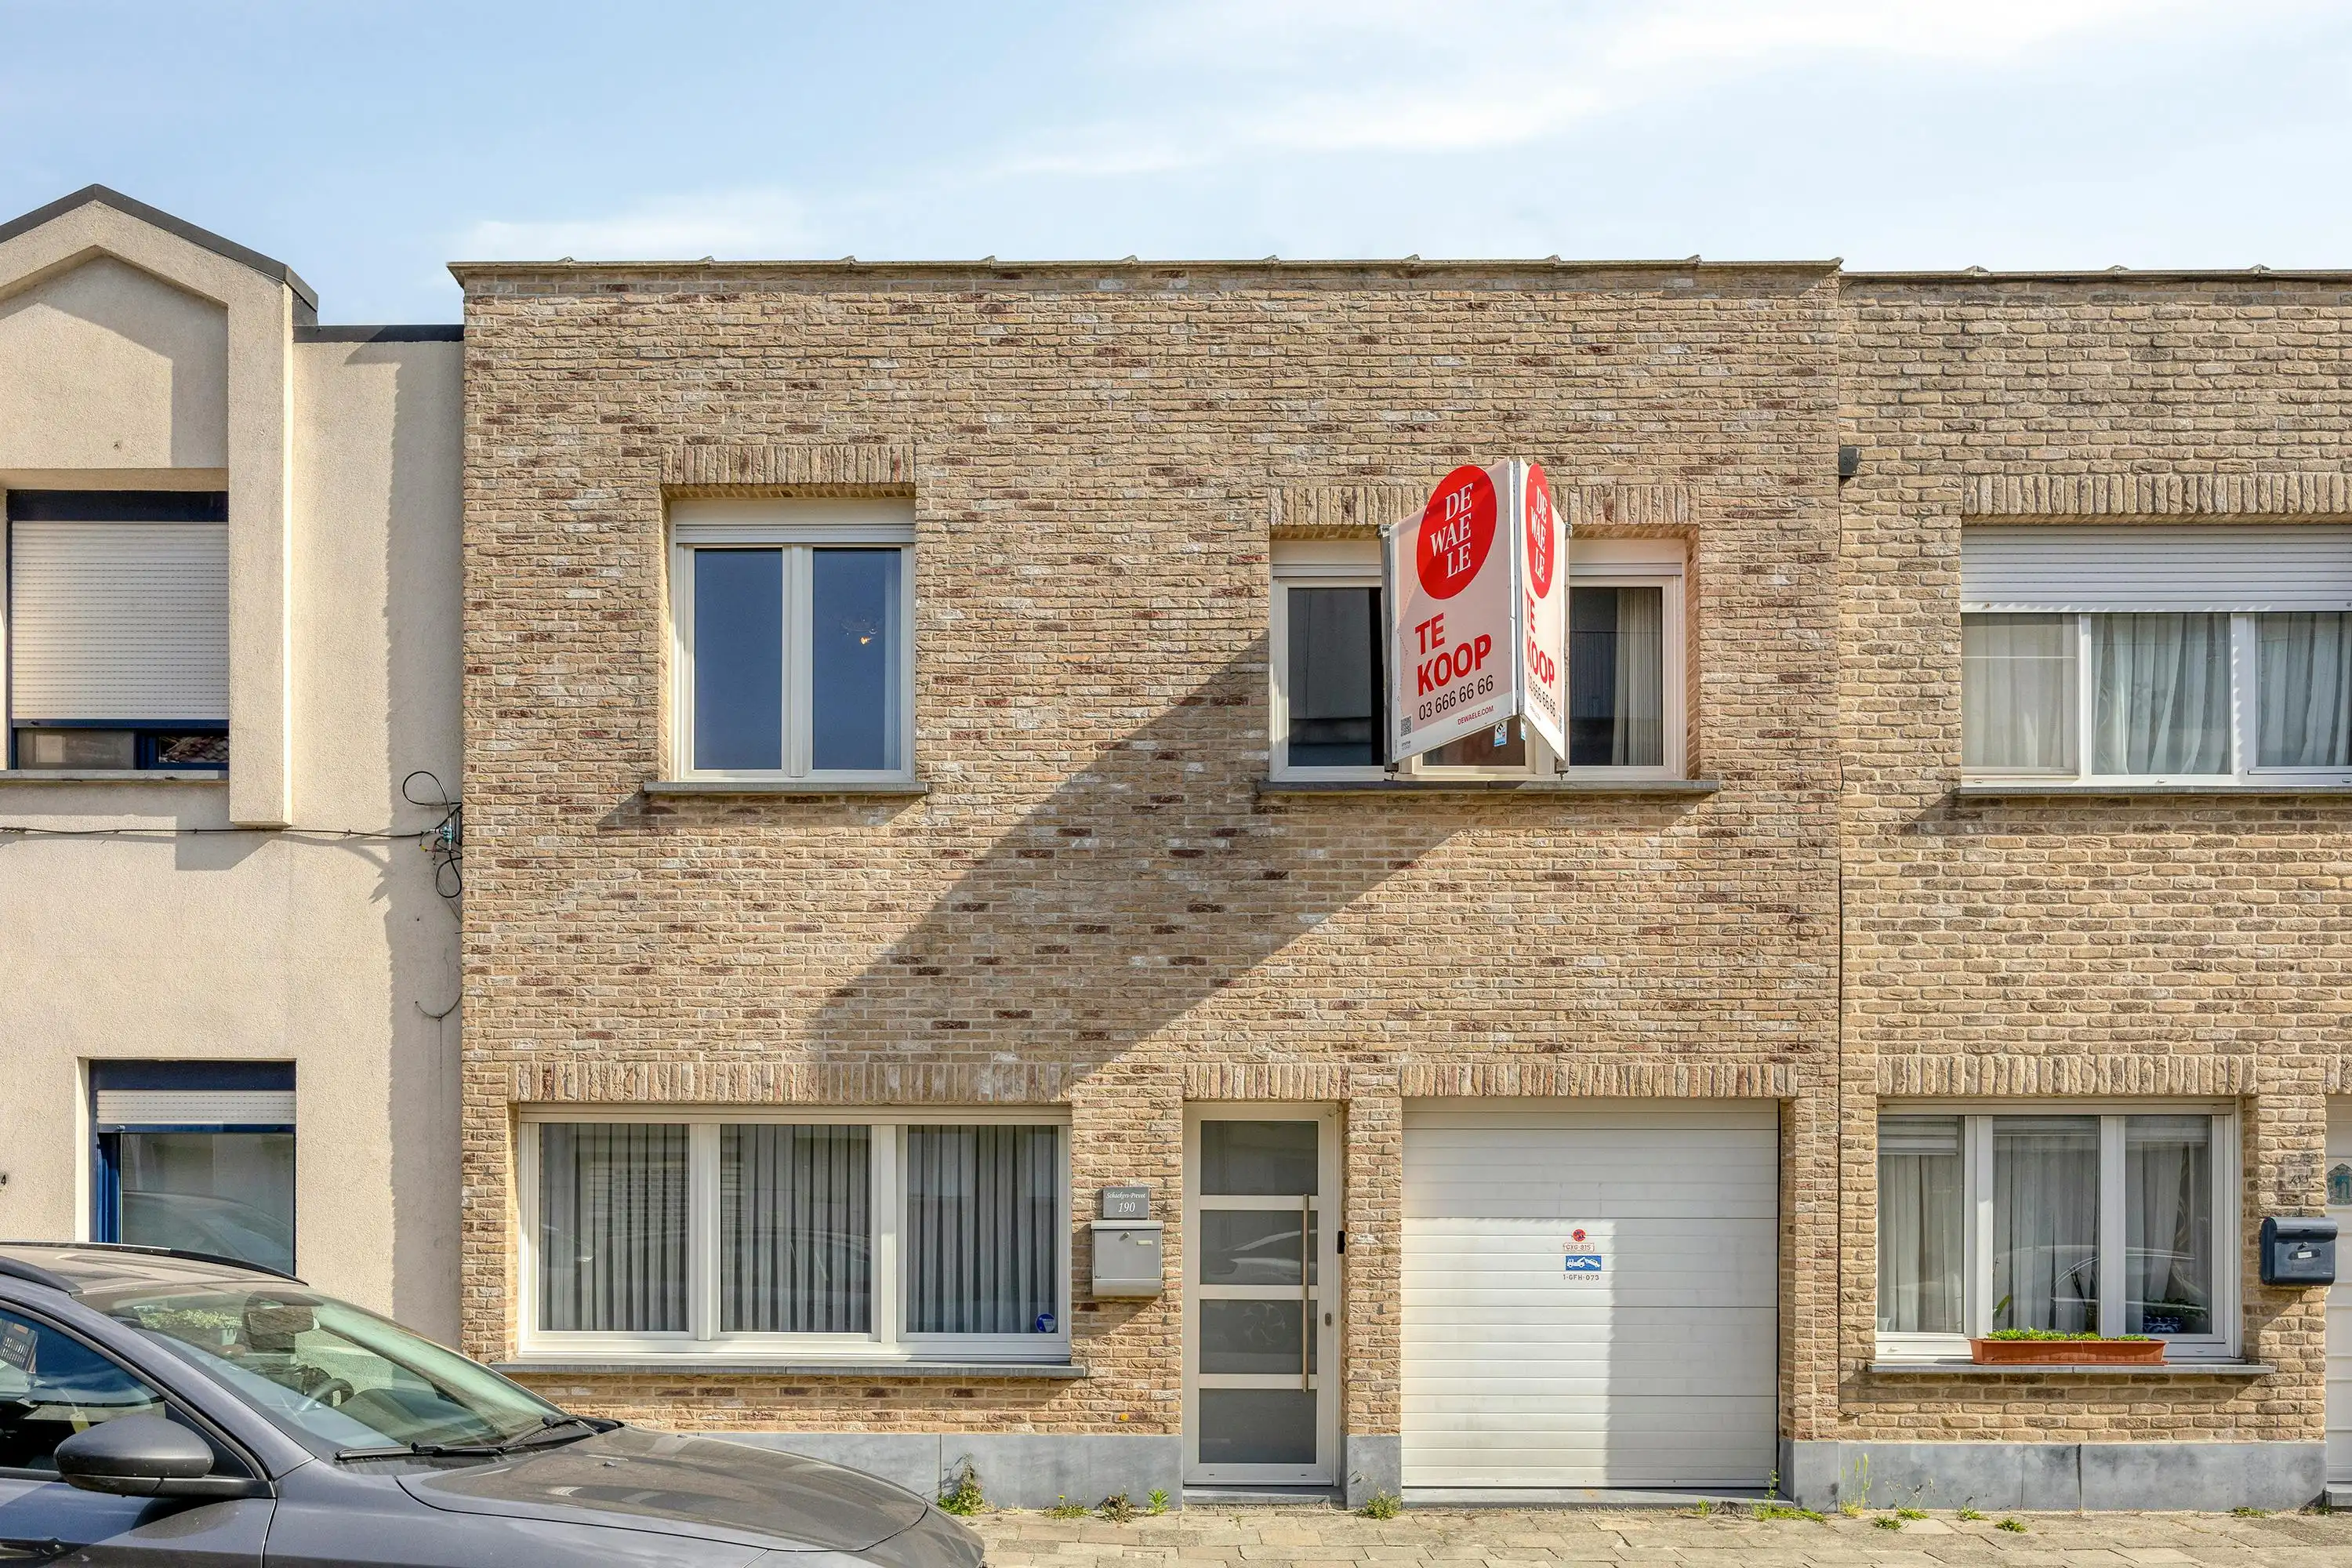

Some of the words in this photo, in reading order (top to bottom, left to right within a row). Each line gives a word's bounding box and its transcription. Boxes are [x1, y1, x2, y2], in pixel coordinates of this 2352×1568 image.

[1444, 482, 1474, 522] DE
[1536, 485, 1548, 524] DE
[1429, 512, 1472, 557] WAE
[1530, 506, 1547, 554] WAE
[1446, 542, 1472, 579] LE
[1534, 546, 1545, 583] LE
[1526, 587, 1536, 633] TE
[1414, 612, 1446, 655] TE
[1417, 633, 1492, 697] KOOP
[1526, 630, 1555, 689] KOOP
[1419, 701, 1432, 720] 03
[1435, 690, 1456, 713] 666
[1459, 683, 1475, 702] 66
[1478, 674, 1494, 695] 66
[1457, 705, 1494, 725] DEWAELE.COM
[1118, 1201, 1136, 1212] 190
